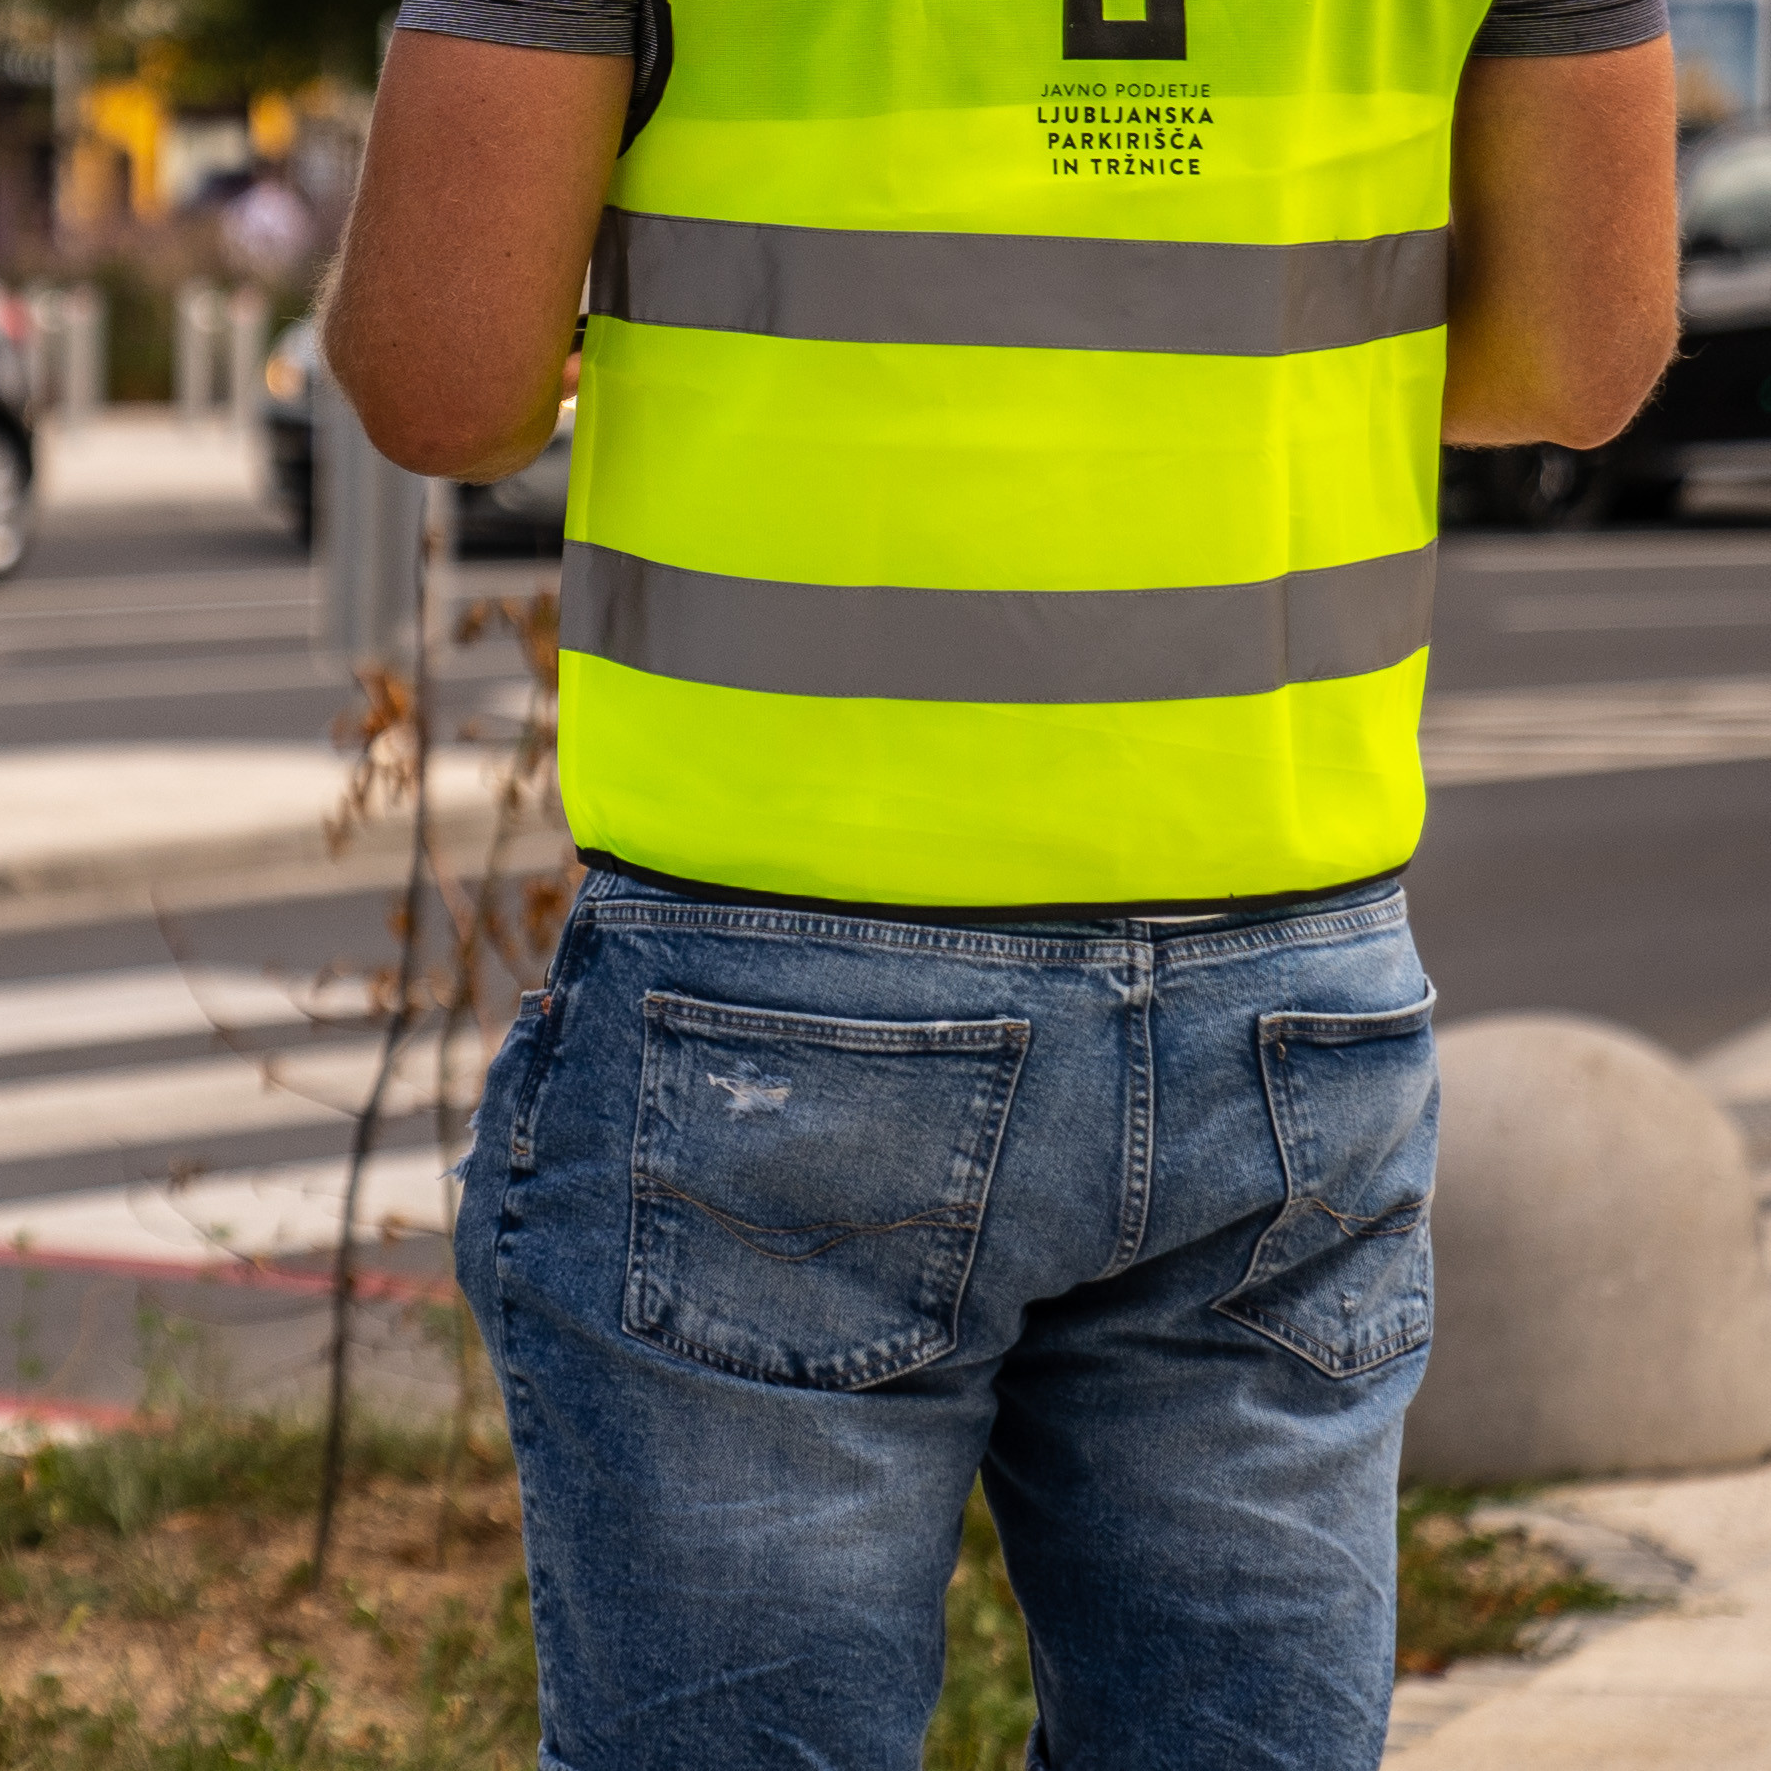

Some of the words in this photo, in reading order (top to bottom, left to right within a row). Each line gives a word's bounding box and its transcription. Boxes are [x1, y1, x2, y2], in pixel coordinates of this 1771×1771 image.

[1041, 83, 1107, 98] JAVNO
[1115, 83, 1210, 98] PODJETJE
[1037, 106, 1214, 124] LJUBLJANSKA
[1048, 127, 1204, 150] PARKIRIŠČA
[1053, 158, 1079, 175] IN
[1090, 153, 1201, 175] TRŽNICE
